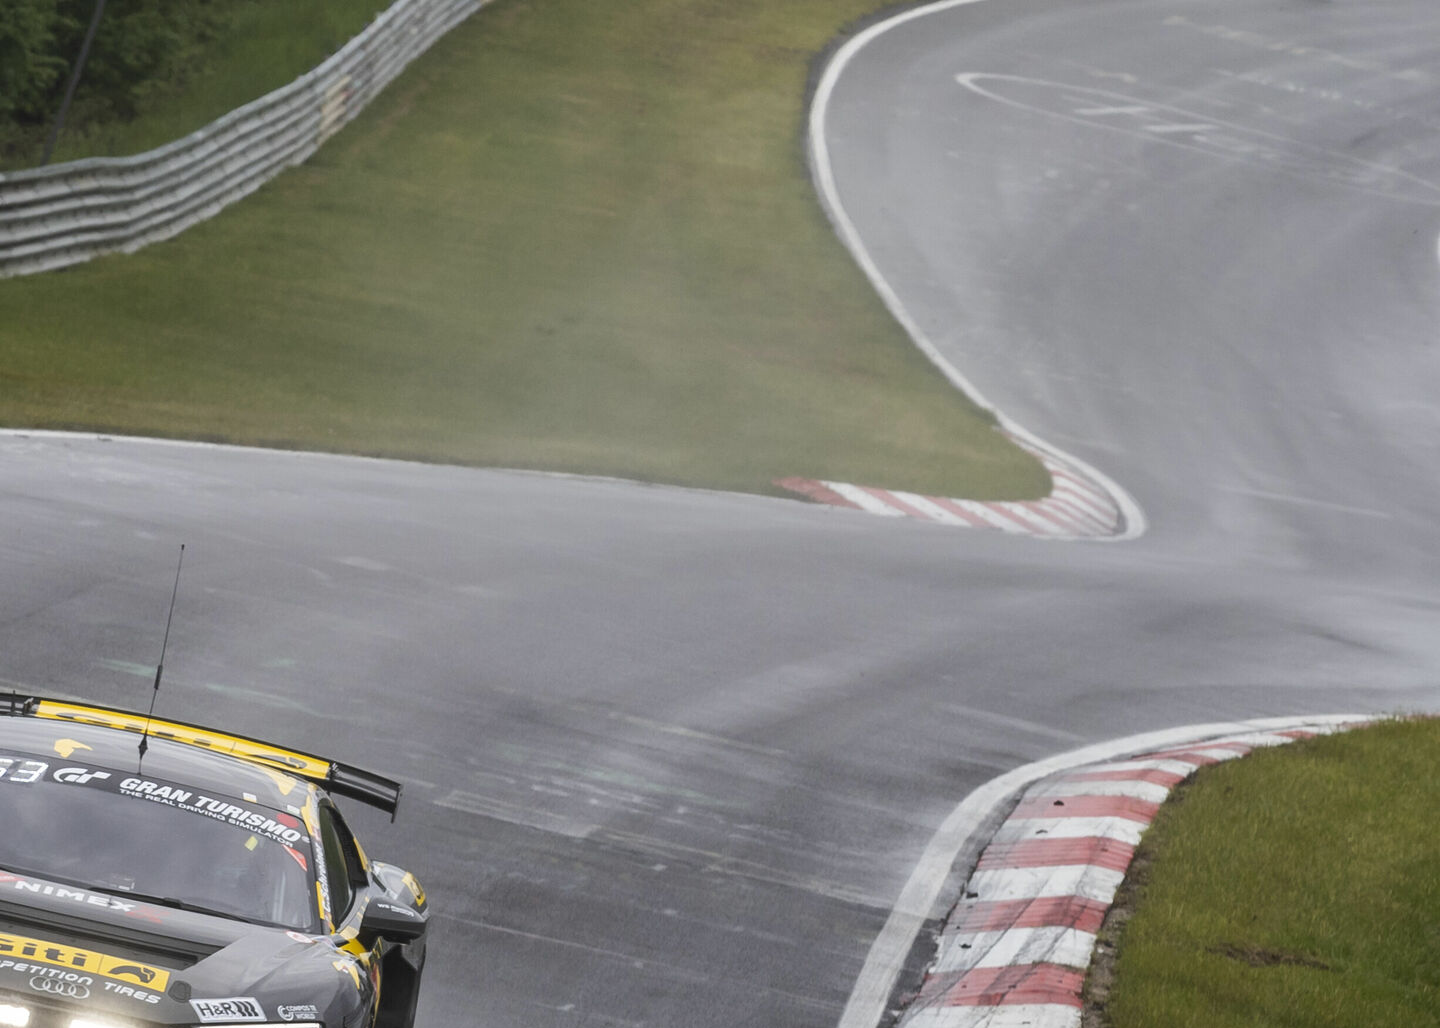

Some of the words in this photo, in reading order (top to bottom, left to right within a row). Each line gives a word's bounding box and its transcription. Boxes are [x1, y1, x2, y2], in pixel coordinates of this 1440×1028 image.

[119, 777, 192, 803] GRAN
[193, 795, 302, 843] TURISMO
[119, 788, 143, 799] THE
[145, 794, 176, 807] REAL
[178, 802, 226, 821] DRIVING
[227, 817, 294, 848] SIMULATOR
[14, 880, 137, 912] NIMEX
[103, 981, 162, 1005] TIRES
